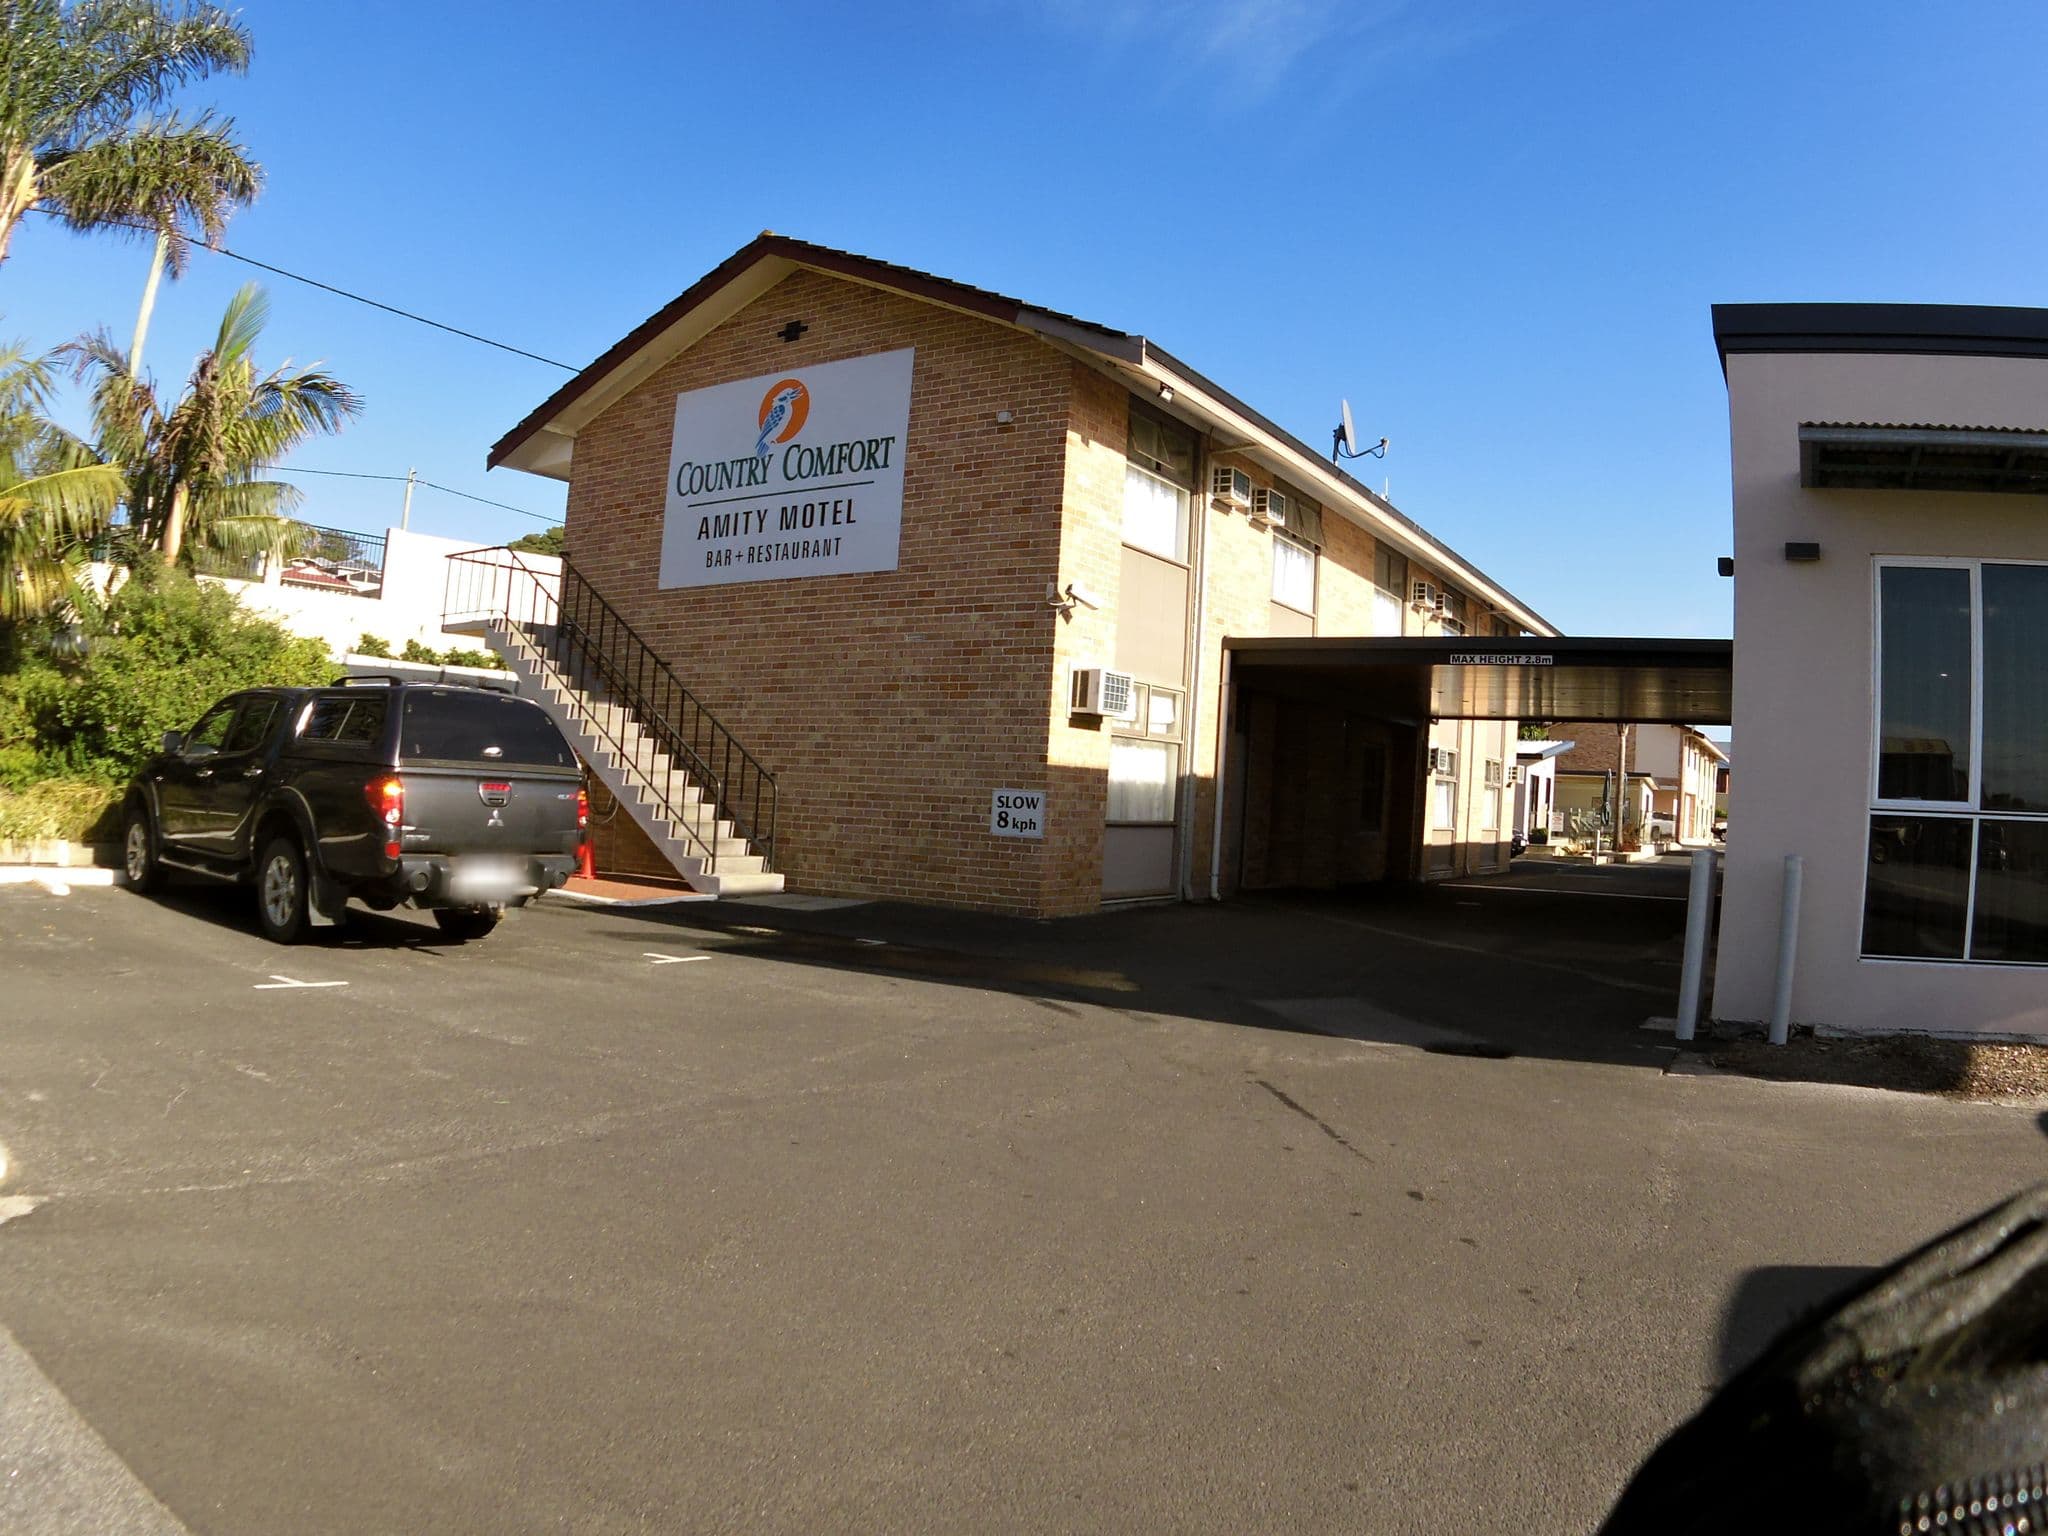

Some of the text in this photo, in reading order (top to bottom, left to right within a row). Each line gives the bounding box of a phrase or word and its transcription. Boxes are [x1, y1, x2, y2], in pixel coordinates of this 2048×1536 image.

[677, 437, 895, 496] COUNTRY COMFORT
[697, 499, 856, 540] AMITY MOTEL
[1452, 655, 1551, 664] MAX HEIGHT 2.8m
[997, 795, 1040, 810] SLOW
[997, 811, 1036, 832] 8 kph
